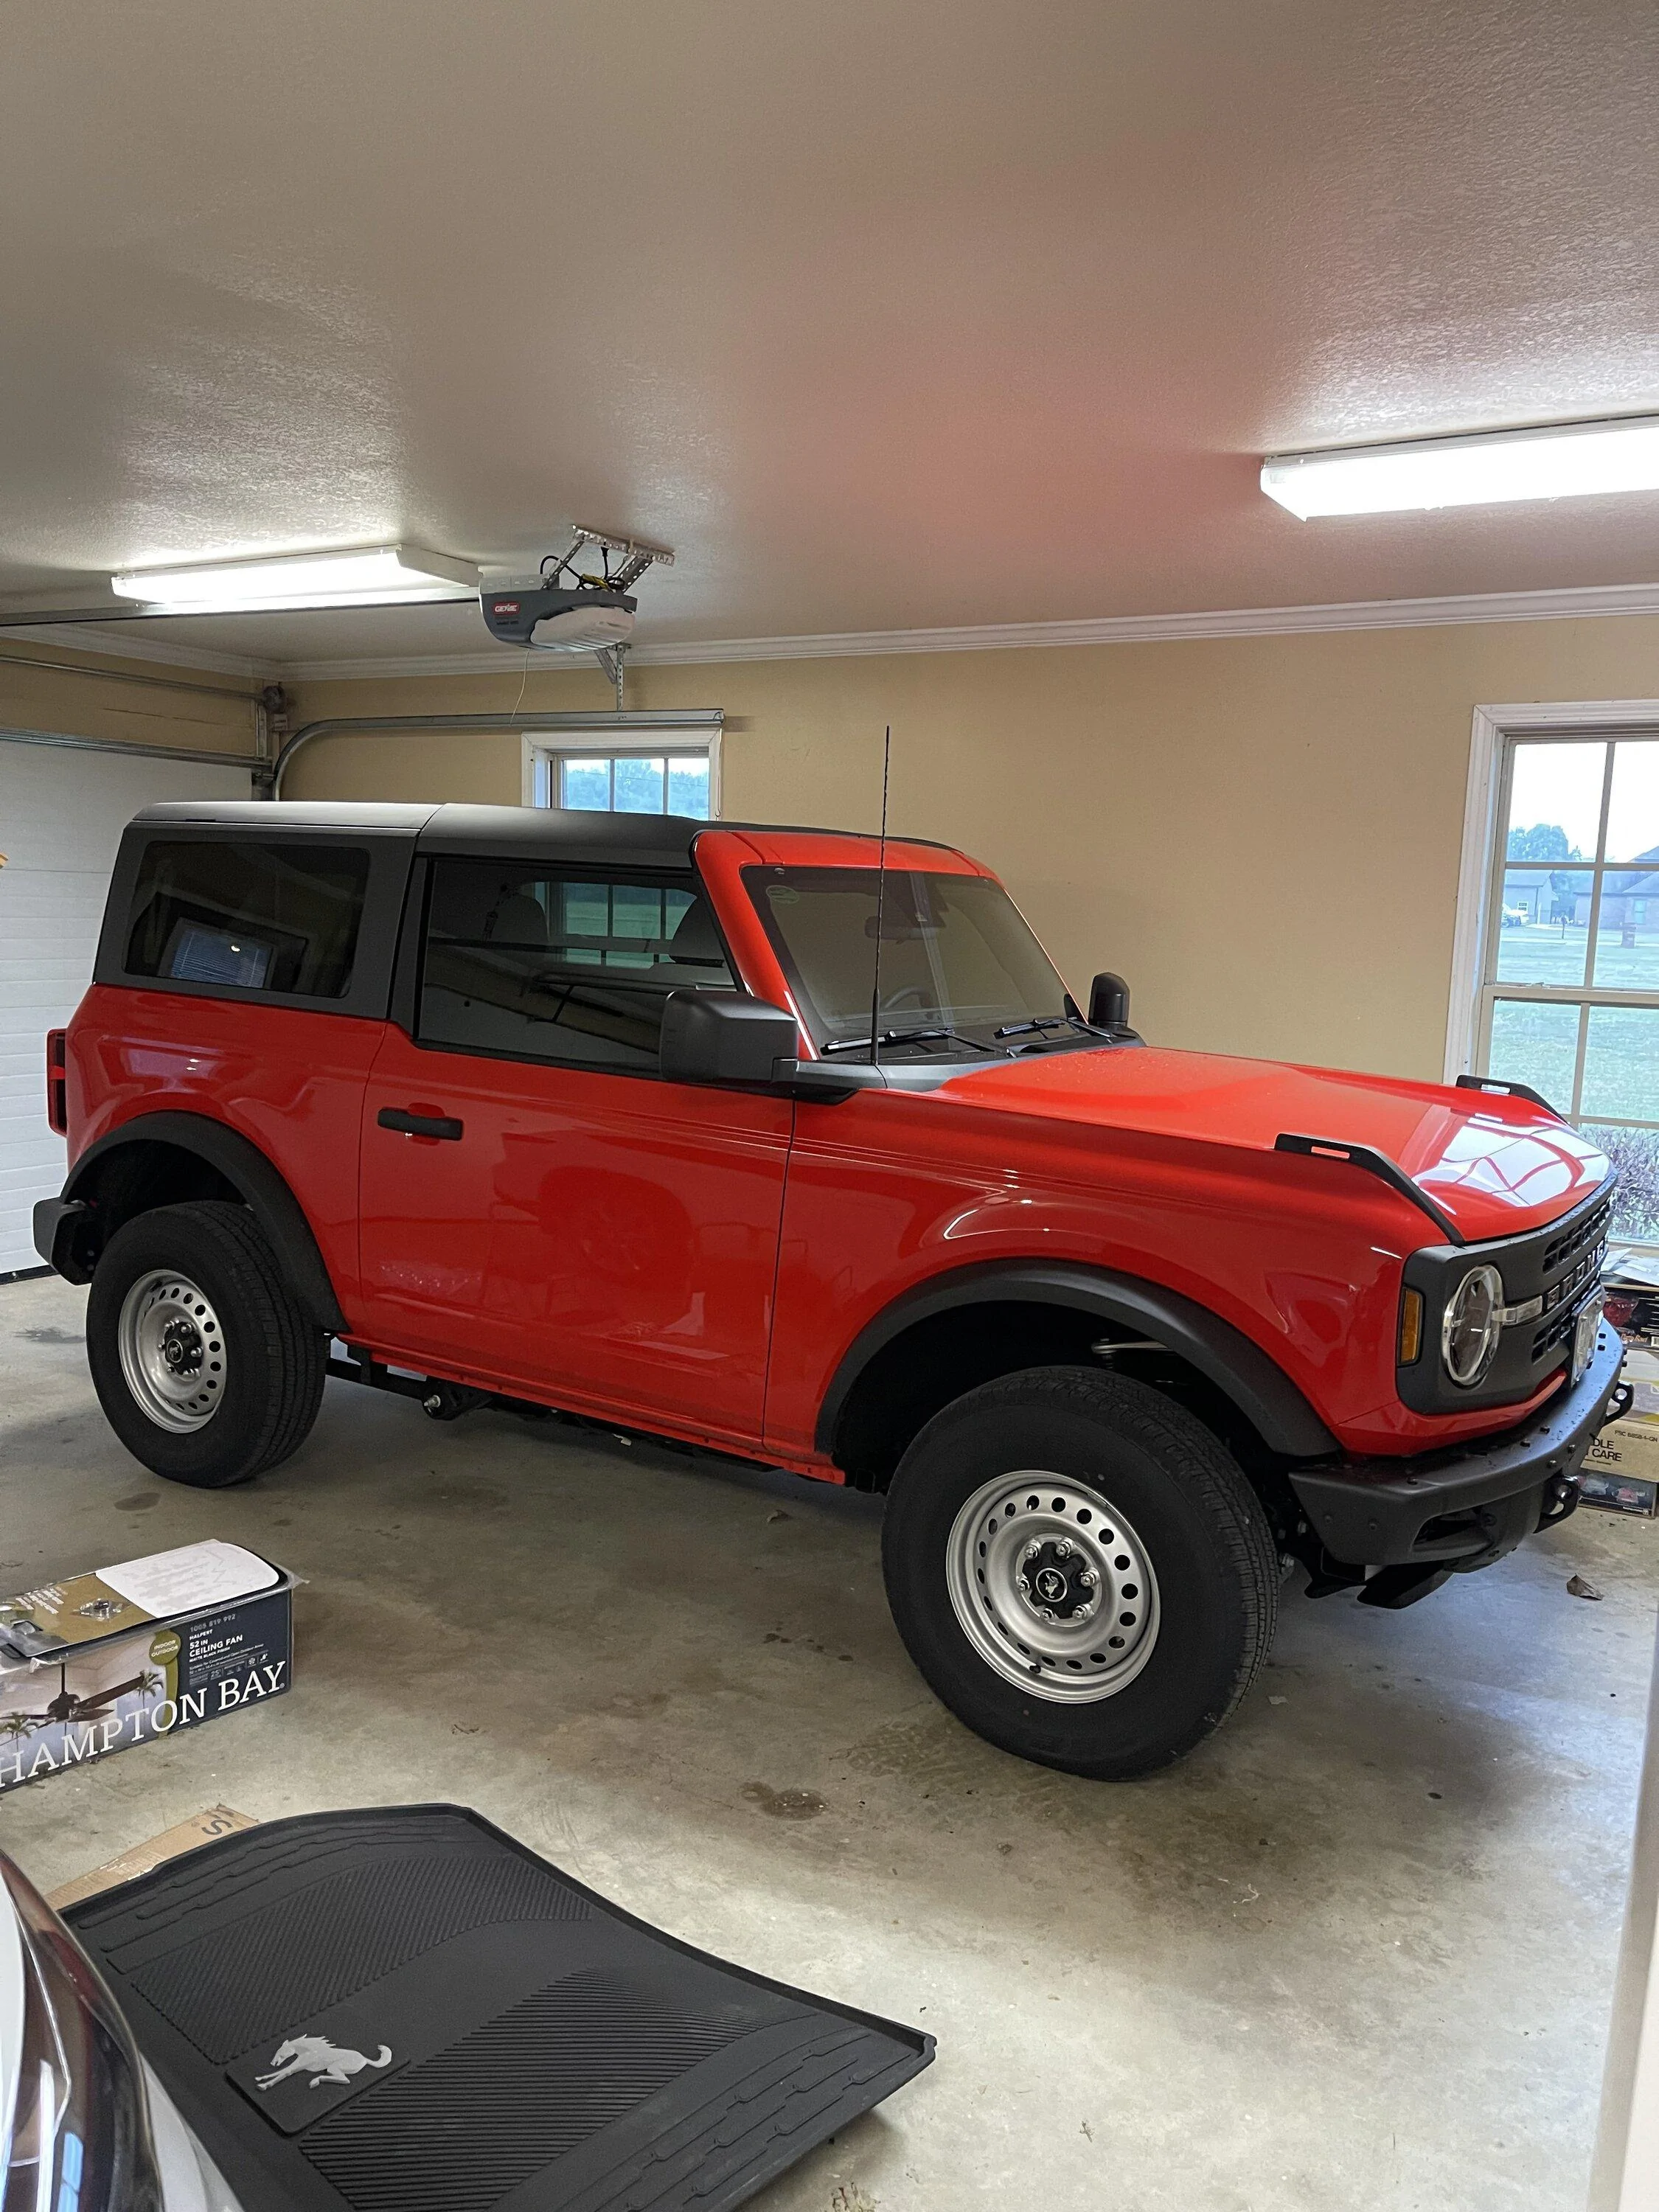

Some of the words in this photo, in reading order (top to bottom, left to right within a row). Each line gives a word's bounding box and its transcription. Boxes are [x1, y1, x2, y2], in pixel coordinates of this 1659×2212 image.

[1592, 1449, 1622, 1461] CARE
[153, 1640, 176, 1649] INDOOR
[189, 1640, 200, 1649] 52
[189, 1641, 223, 1658] CEILING
[226, 1634, 243, 1646] FAN
[151, 1645, 178, 1658] OUTDOOR
[0, 1688, 209, 1788] HAMPTON
[218, 1660, 286, 1711] BAY
